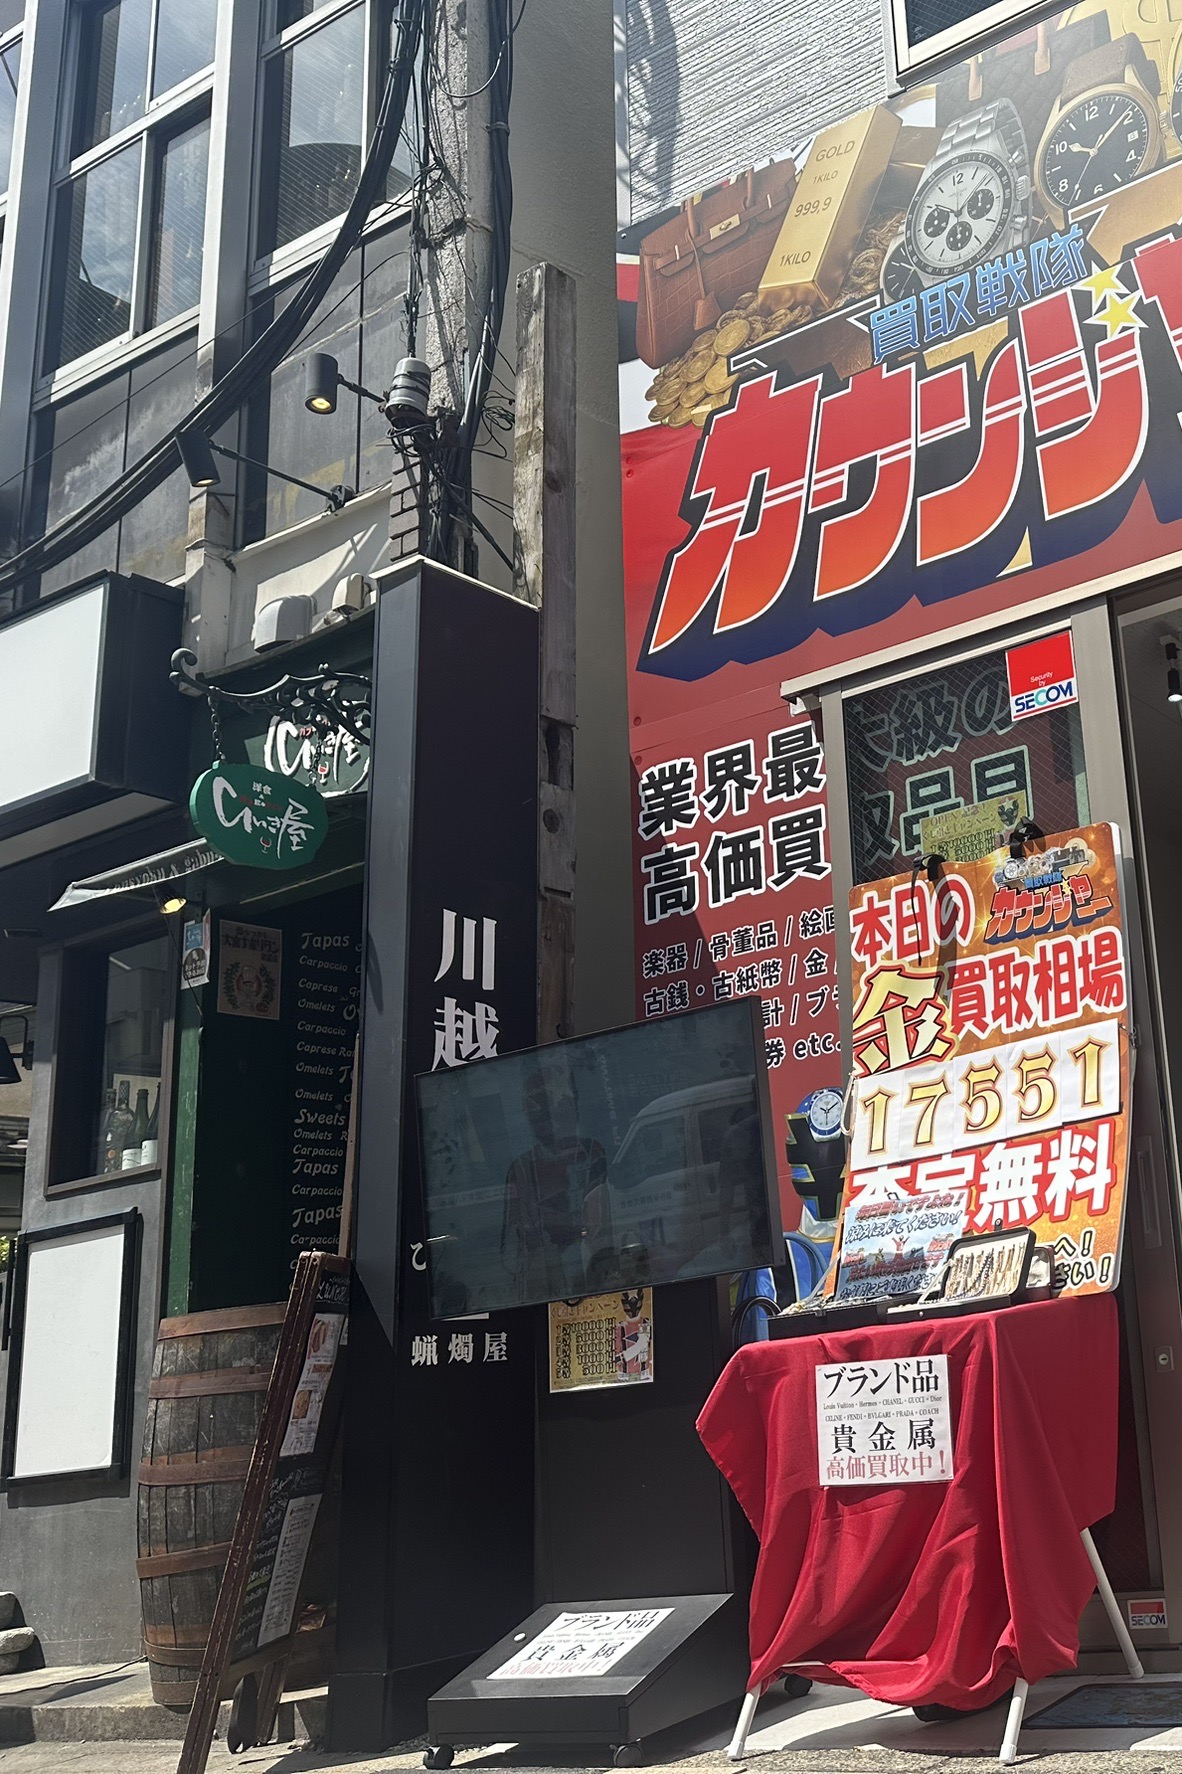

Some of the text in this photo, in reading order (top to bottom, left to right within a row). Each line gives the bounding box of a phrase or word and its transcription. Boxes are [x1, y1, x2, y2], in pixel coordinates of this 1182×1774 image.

[815, 140, 855, 163] GOLD
[779, 250, 811, 267] 1KILO
[869, 224, 1089, 364] 買取戦隊
[1030, 671, 1053, 682] Security
[1015, 681, 1073, 713] SECOM
[638, 720, 826, 840] 業界最
[641, 804, 832, 924] 高価買
[984, 875, 1113, 944] カウンジャー
[851, 875, 975, 970] 本日の
[301, 932, 350, 950] Tapas
[643, 943, 688, 979] 楽器
[709, 920, 778, 962] 骨董品
[299, 955, 348, 972] Carpaccio
[298, 978, 338, 993] Caprese
[644, 958, 782, 1016] 古銭・古紙幣
[803, 947, 828, 978] 金
[298, 999, 336, 1013] Omelets
[297, 1020, 347, 1036] Carpaccio
[296, 1041, 337, 1056] Caprese
[792, 1032, 841, 1060] etc.
[295, 1062, 334, 1076] Omelets
[295, 1088, 334, 1102] Omelets
[861, 1034, 1112, 1155] 17551
[294, 1108, 346, 1126] Sweets
[293, 1128, 333, 1141] Omelets
[292, 1144, 344, 1158] Carpaccio
[292, 1158, 339, 1177] Tapas
[291, 1183, 343, 1197] Carpaccio
[292, 1204, 343, 1229] Tapas
[411, 1332, 508, 1367] 蝋燭屋
[824, 1359, 939, 1398] ブランド品
[859, 1400, 877, 1408] Hermes
[882, 1398, 903, 1406] CHANEL
[908, 1396, 925, 1404] GUCCI
[930, 1395, 942, 1403] Dior
[825, 1407, 940, 1422] CELINE FENDI BVLGARI PRADA COACH
[831, 1418, 936, 1454] 貴金属
[826, 1449, 945, 1480] 高価買取中!
[1131, 1614, 1166, 1626] SECOM
